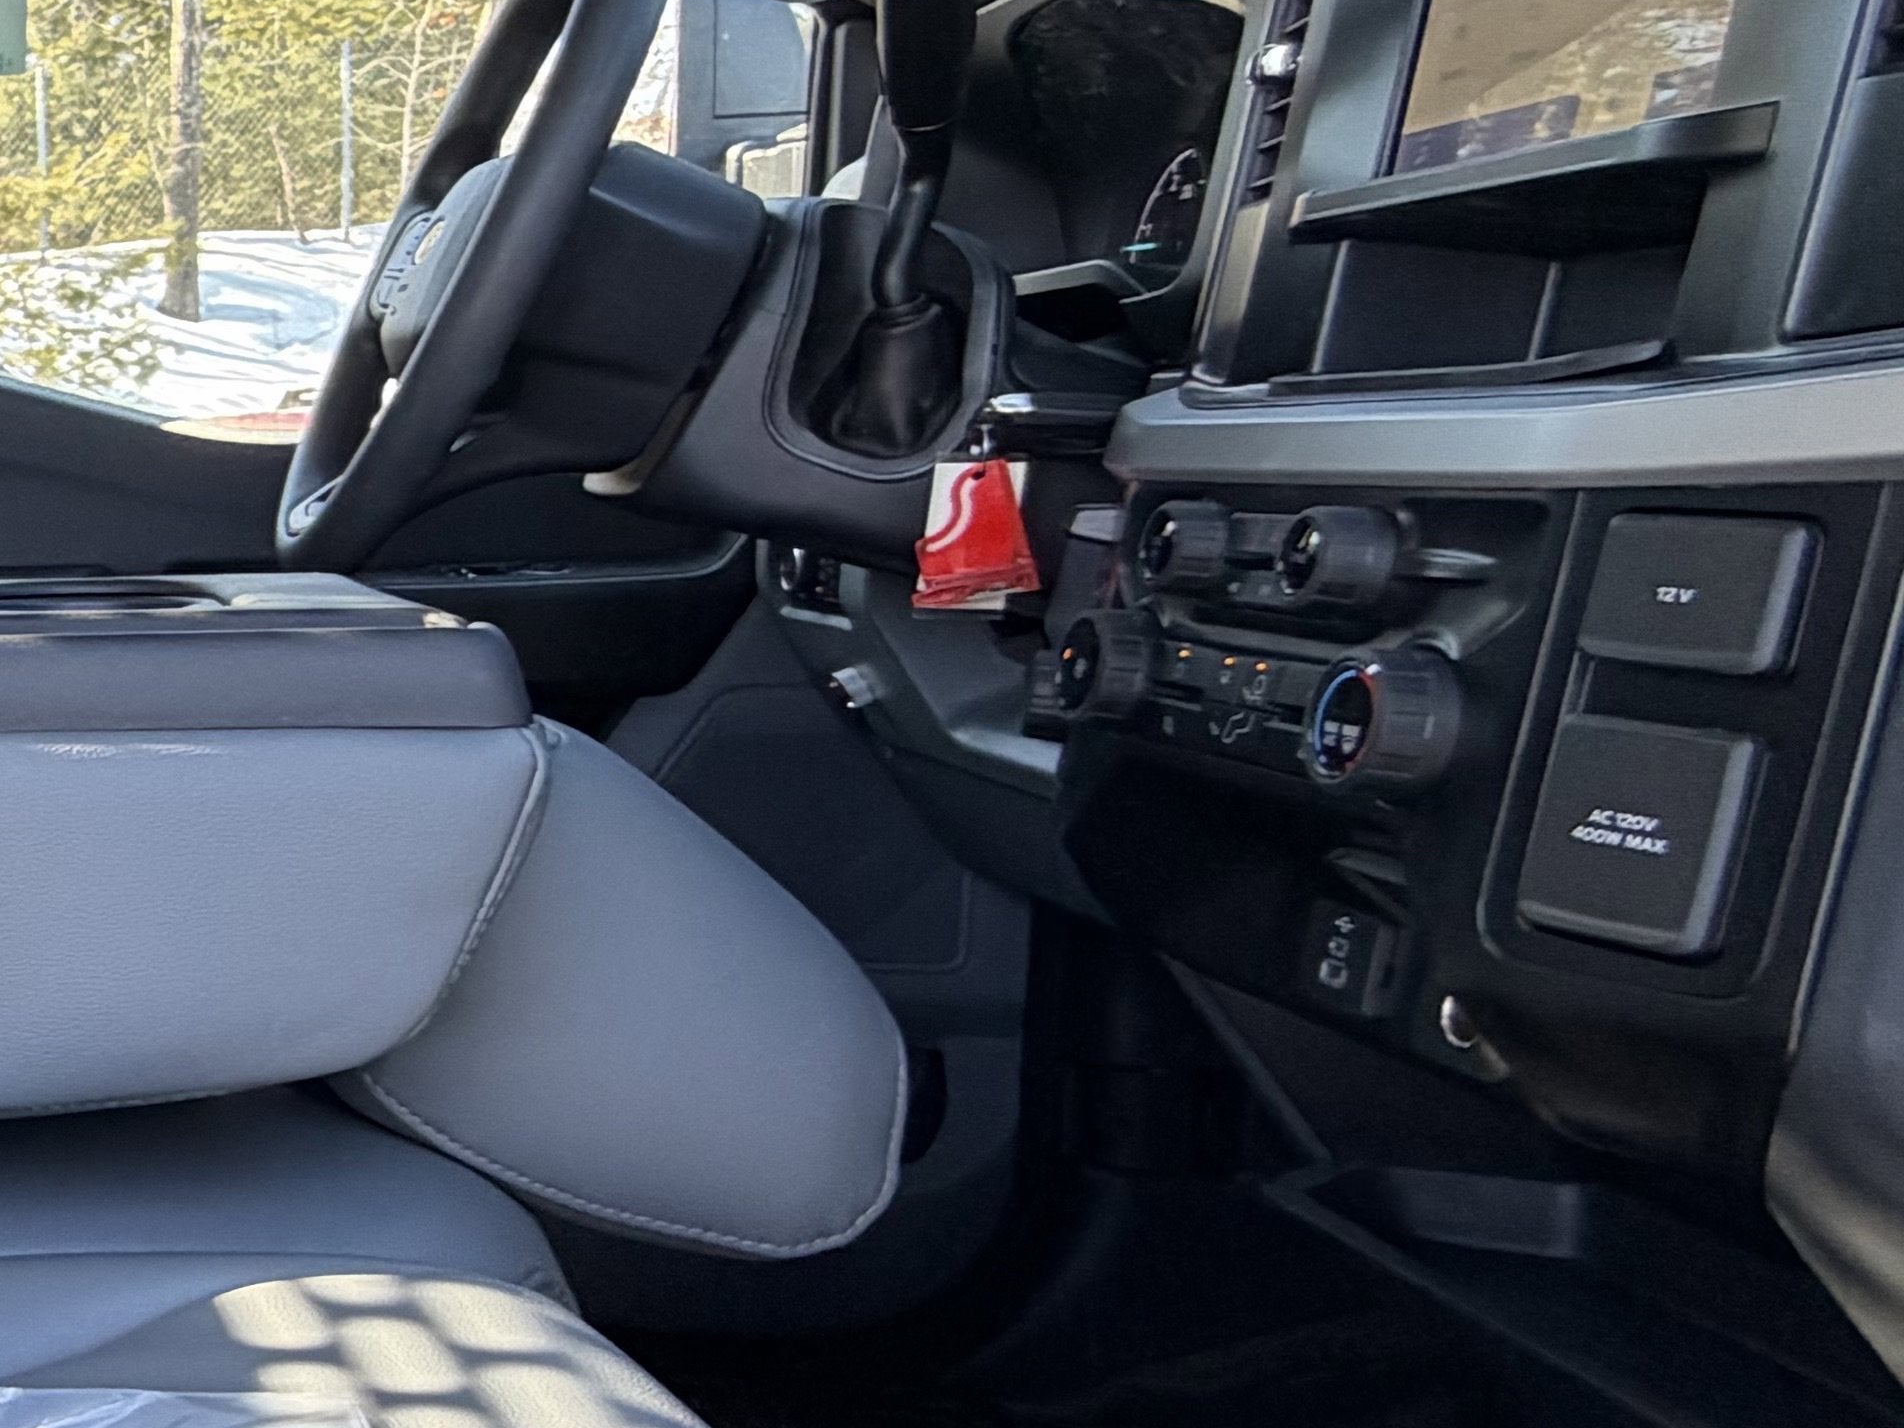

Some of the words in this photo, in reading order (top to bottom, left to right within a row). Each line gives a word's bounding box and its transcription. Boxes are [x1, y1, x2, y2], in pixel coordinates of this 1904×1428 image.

[1587, 809, 1615, 826] AC
[1616, 812, 1659, 832] 120V
[1570, 825, 1624, 846] 400W
[1623, 834, 1669, 855] MAX
